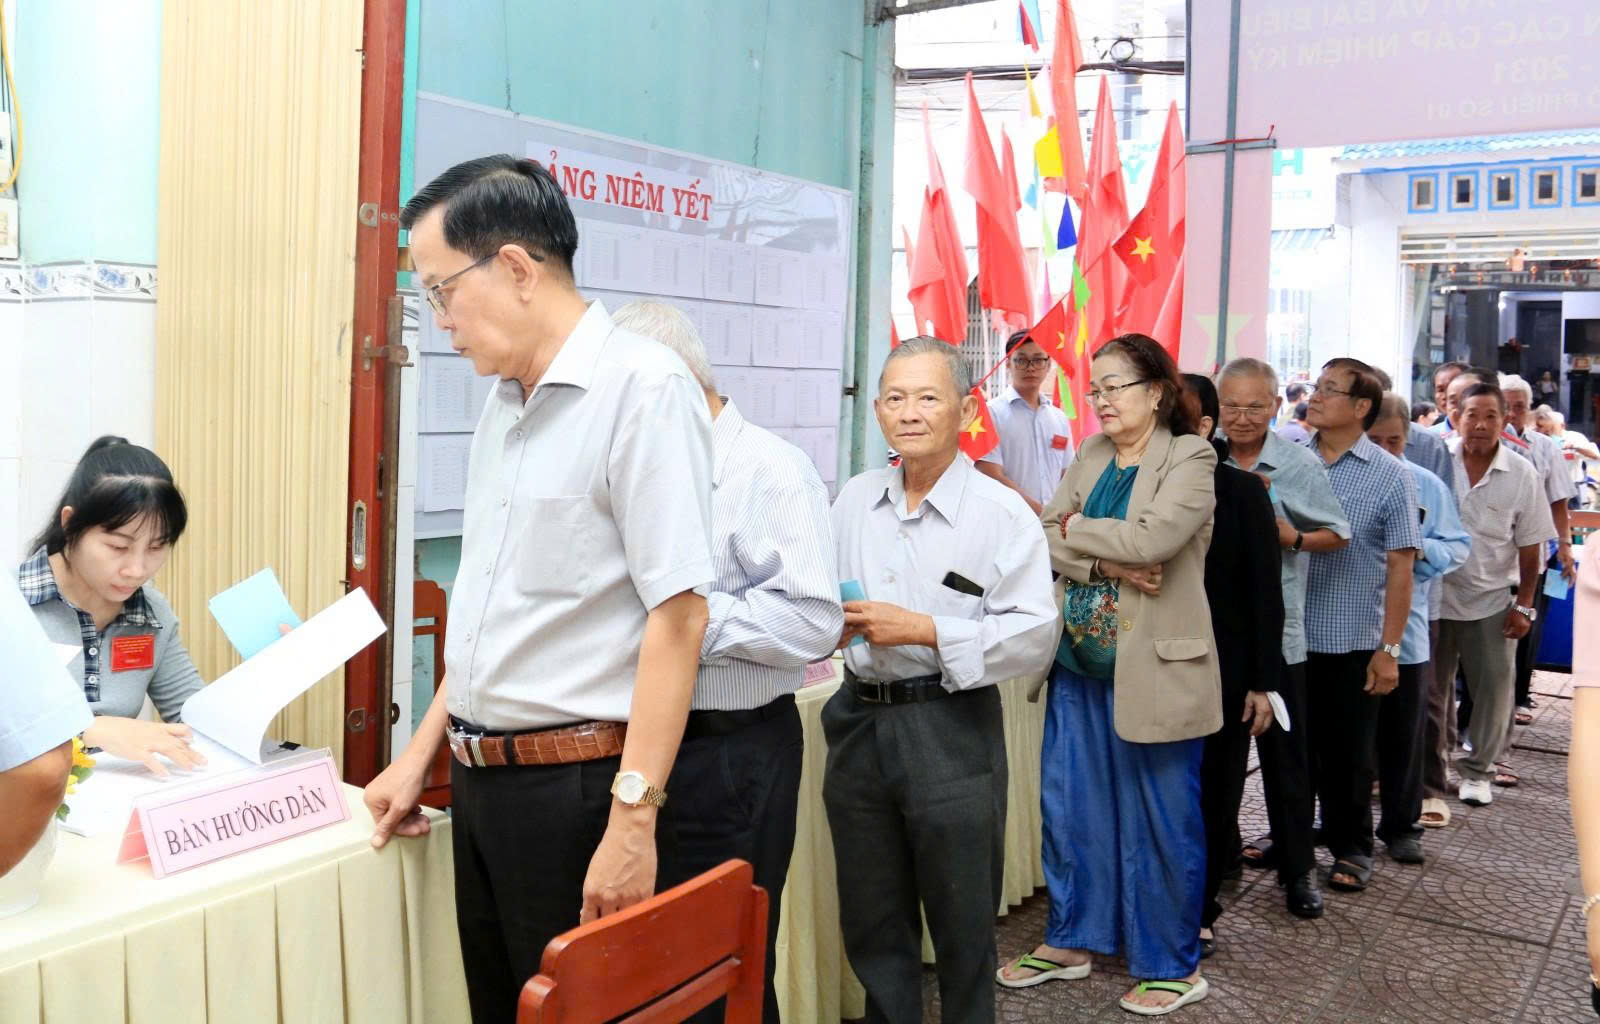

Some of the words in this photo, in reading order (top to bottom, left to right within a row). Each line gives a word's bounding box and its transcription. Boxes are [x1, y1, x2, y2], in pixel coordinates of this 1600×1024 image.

[528, 150, 597, 201] ẢNG
[605, 171, 665, 213] NIÊM
[671, 178, 713, 222] YẾT
[164, 818, 211, 856] BÀN
[211, 800, 285, 841] HƯỚNG
